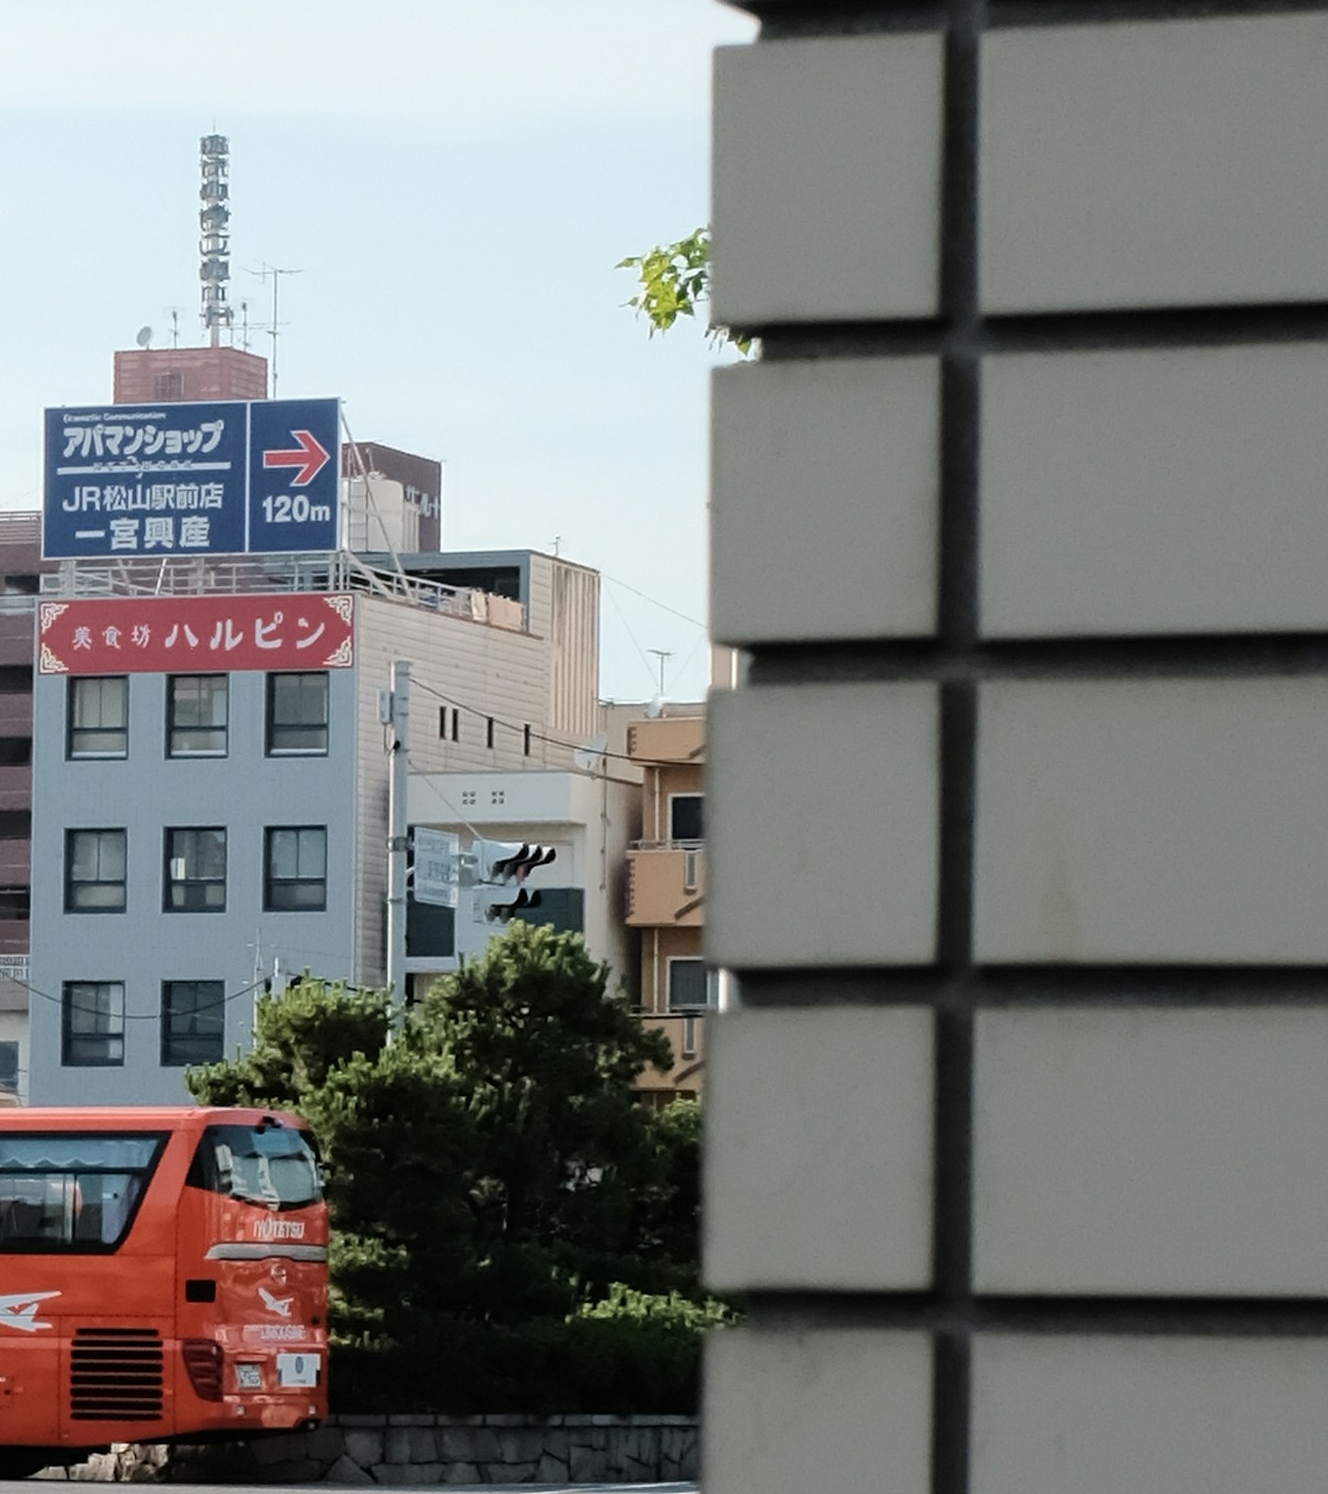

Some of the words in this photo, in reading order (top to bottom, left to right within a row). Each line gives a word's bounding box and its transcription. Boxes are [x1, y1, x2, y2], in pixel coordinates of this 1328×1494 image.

[62, 419, 225, 457] アパマンショップ
[62, 482, 225, 512] JR松山駅前店
[262, 494, 331, 523] 120m
[75, 515, 211, 550] 一宮興産
